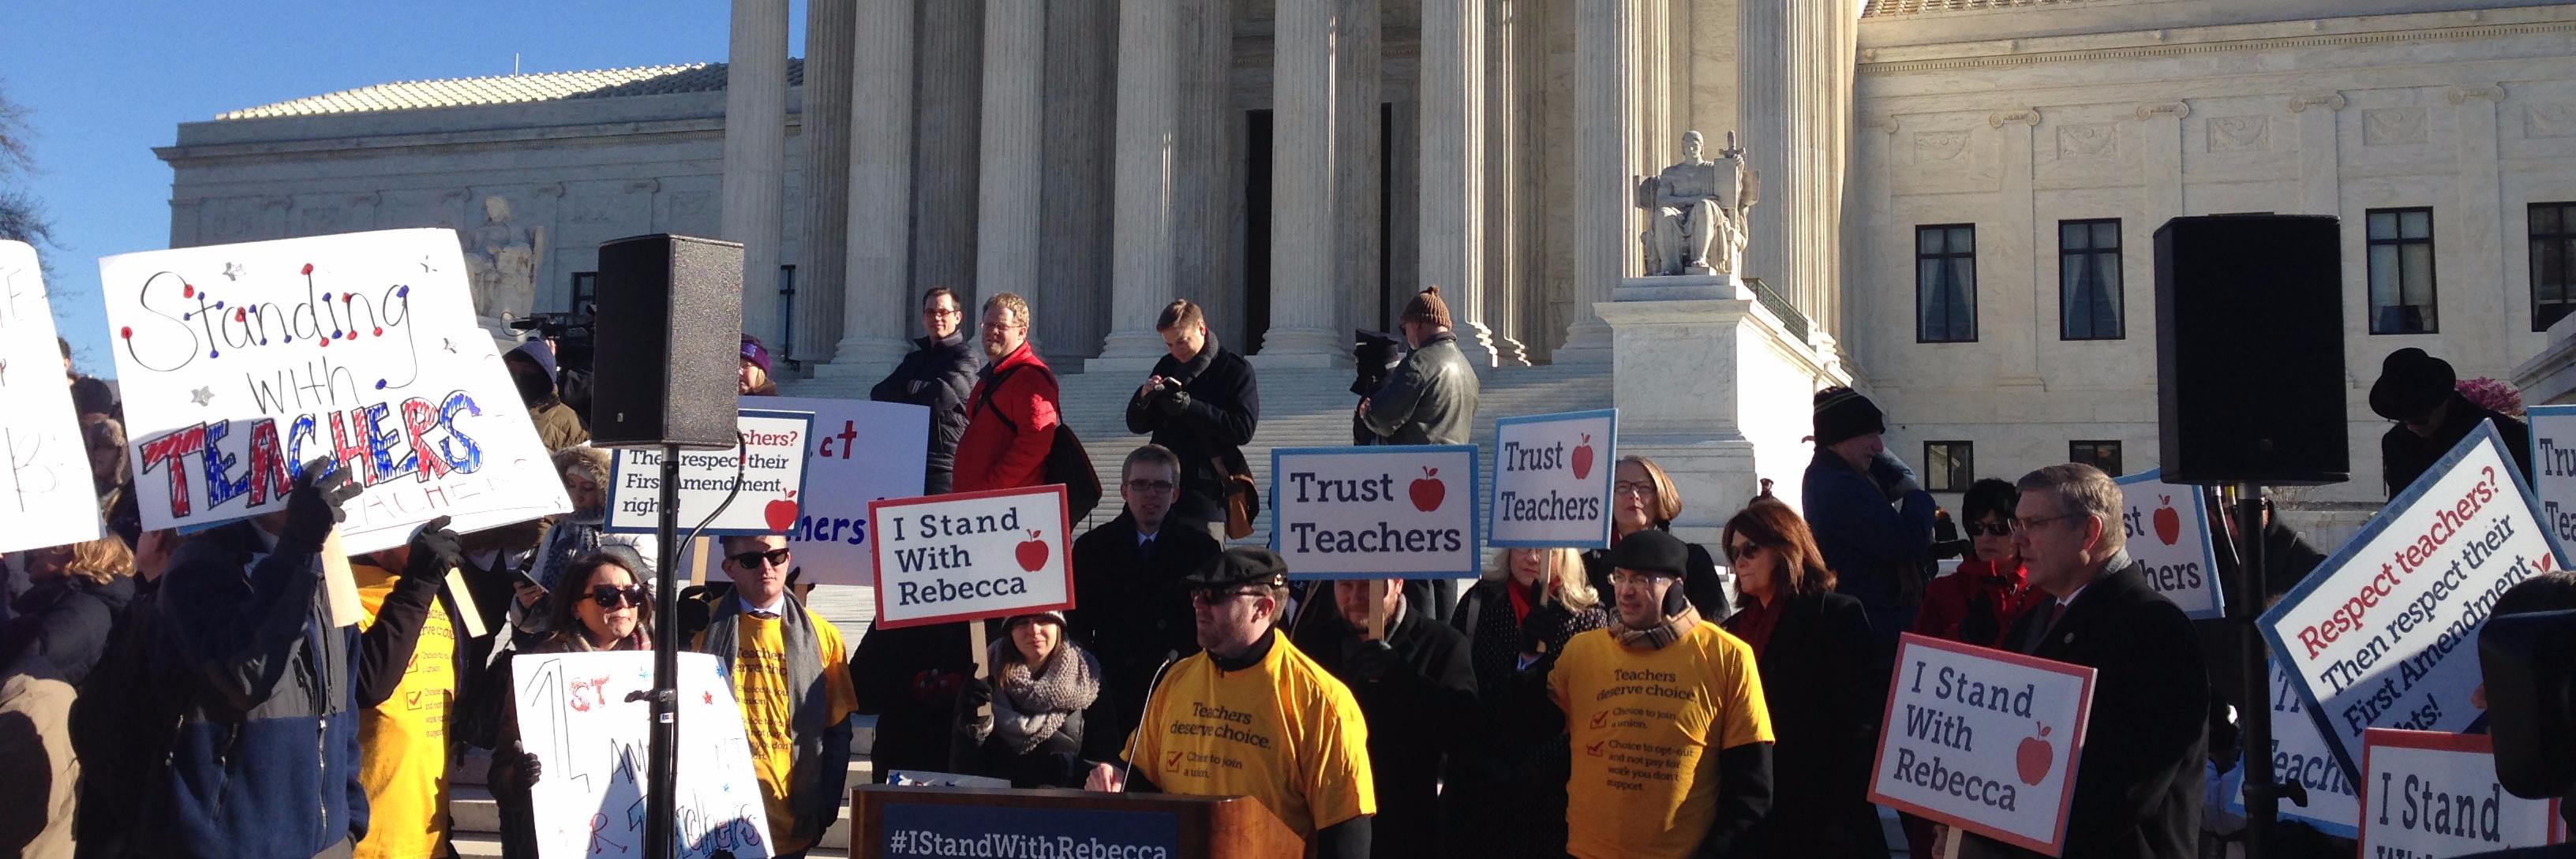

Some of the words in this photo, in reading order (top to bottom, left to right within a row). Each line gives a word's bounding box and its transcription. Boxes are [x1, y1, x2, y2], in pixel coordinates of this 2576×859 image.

[121, 263, 417, 390] Standing
[139, 390, 483, 517] TEACHERS
[630, 450, 661, 465] The
[681, 454, 740, 471] respec
[748, 454, 789, 469] their
[1503, 440, 1563, 472] Trust
[2539, 438, 2576, 478] Tru
[625, 473, 660, 489] Firs
[1290, 472, 1395, 503] Trust
[1500, 491, 1599, 523] Teachers
[893, 517, 906, 541] I
[919, 507, 1020, 539] Stand
[1290, 521, 1462, 554] Teachers
[894, 544, 972, 573] With
[2297, 562, 2401, 661] Respect
[2394, 465, 2500, 575] teachers?
[898, 573, 1027, 607] Rebecca
[2320, 635, 2391, 697] Then
[2386, 559, 2468, 644] respect
[2462, 514, 2515, 570] their
[2342, 677, 2402, 738] First
[2399, 554, 2532, 692] Amendment
[1614, 668, 1676, 683] Teachers
[1911, 661, 1926, 693] I
[1935, 666, 2035, 719] Stand
[1597, 685, 1643, 701] deserve
[1193, 702, 1252, 725] Teachers
[1905, 704, 1973, 753] With
[1214, 724, 1271, 749] choice.
[1893, 747, 2017, 812] Rebecca
[2379, 771, 2391, 826] I
[2402, 774, 2501, 842] Stand
[889, 829, 1168, 859] #IStandWithRebecca
